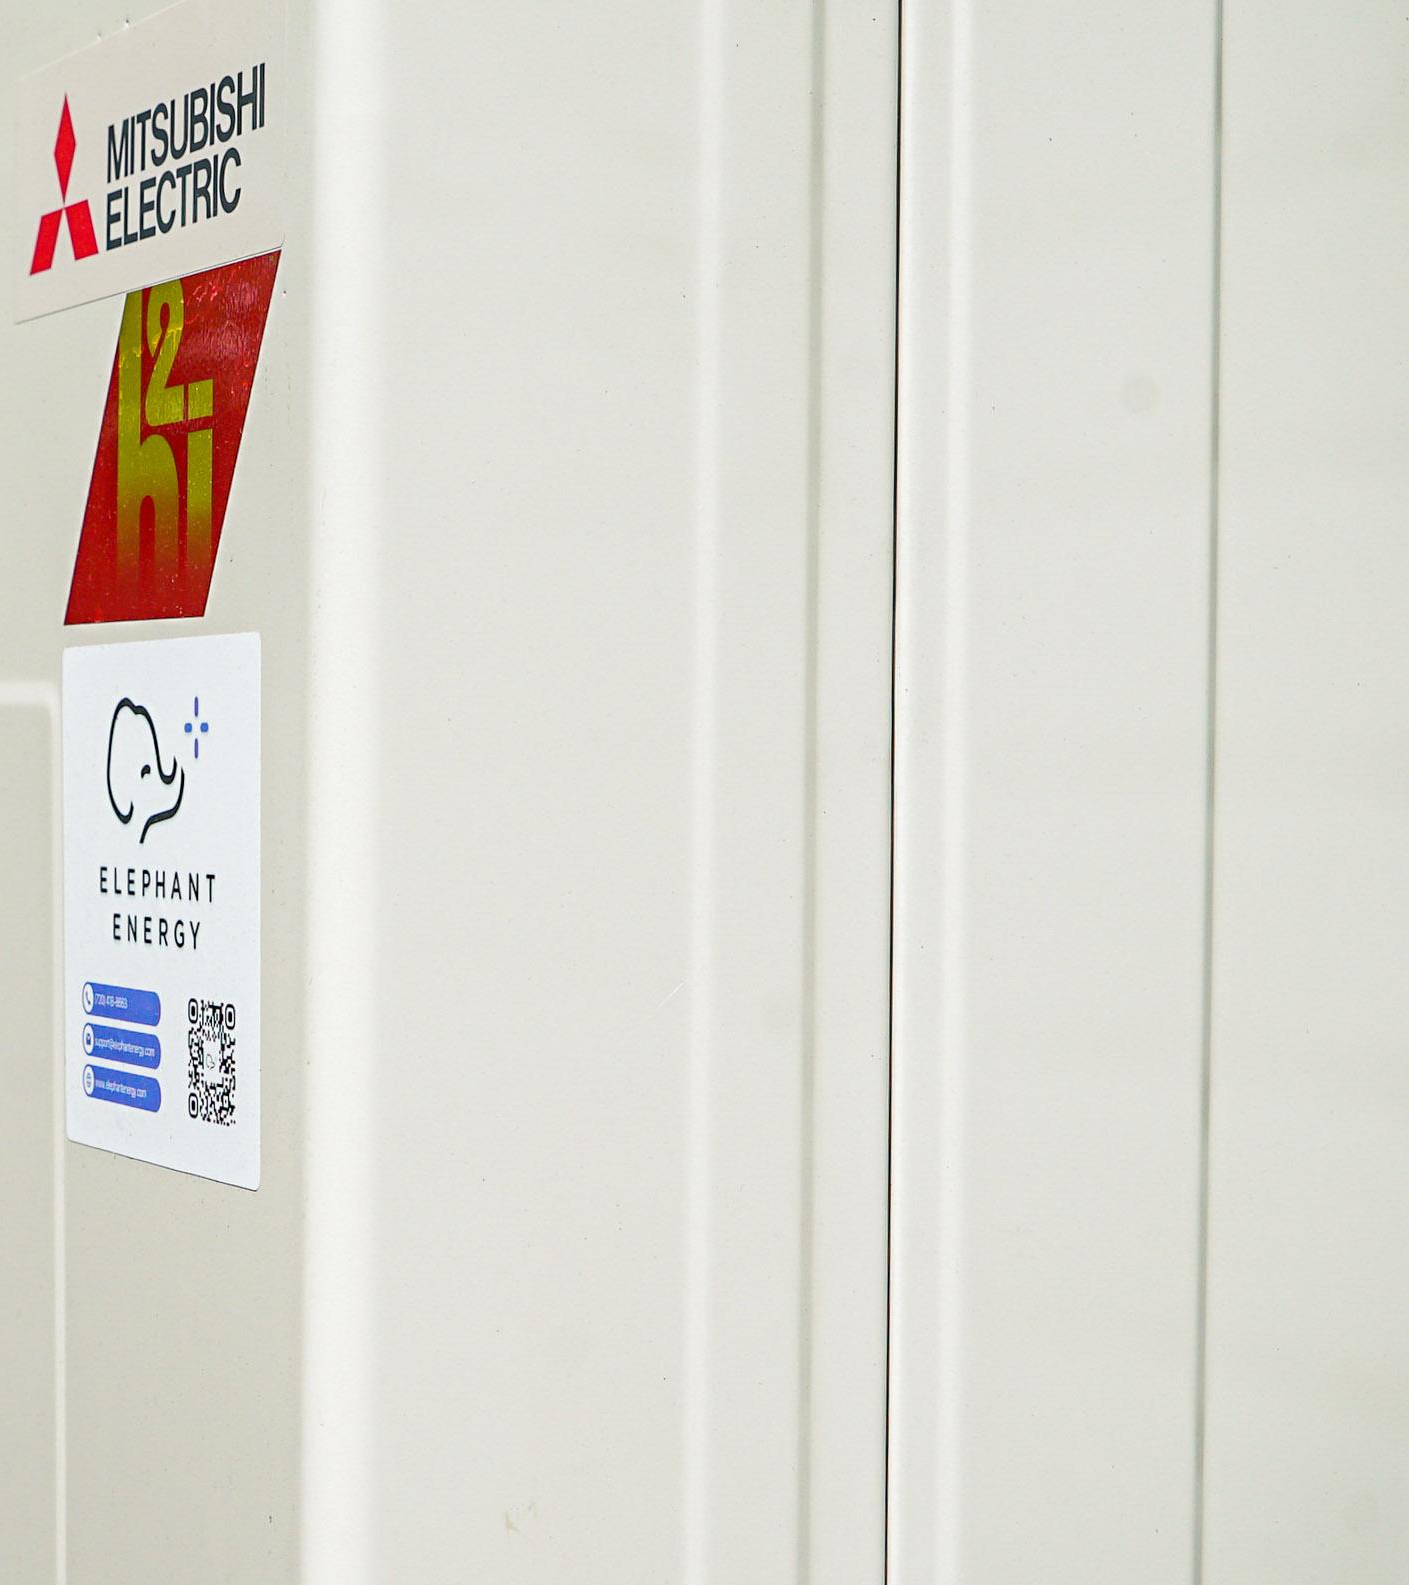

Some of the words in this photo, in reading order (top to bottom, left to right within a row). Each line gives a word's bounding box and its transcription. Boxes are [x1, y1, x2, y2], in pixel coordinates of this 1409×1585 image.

[107, 62, 266, 185] MITSUBISHI
[106, 147, 242, 251] ELECTRIC
[99, 866, 216, 903] ELEPHANT
[112, 912, 200, 950] ENERGY
